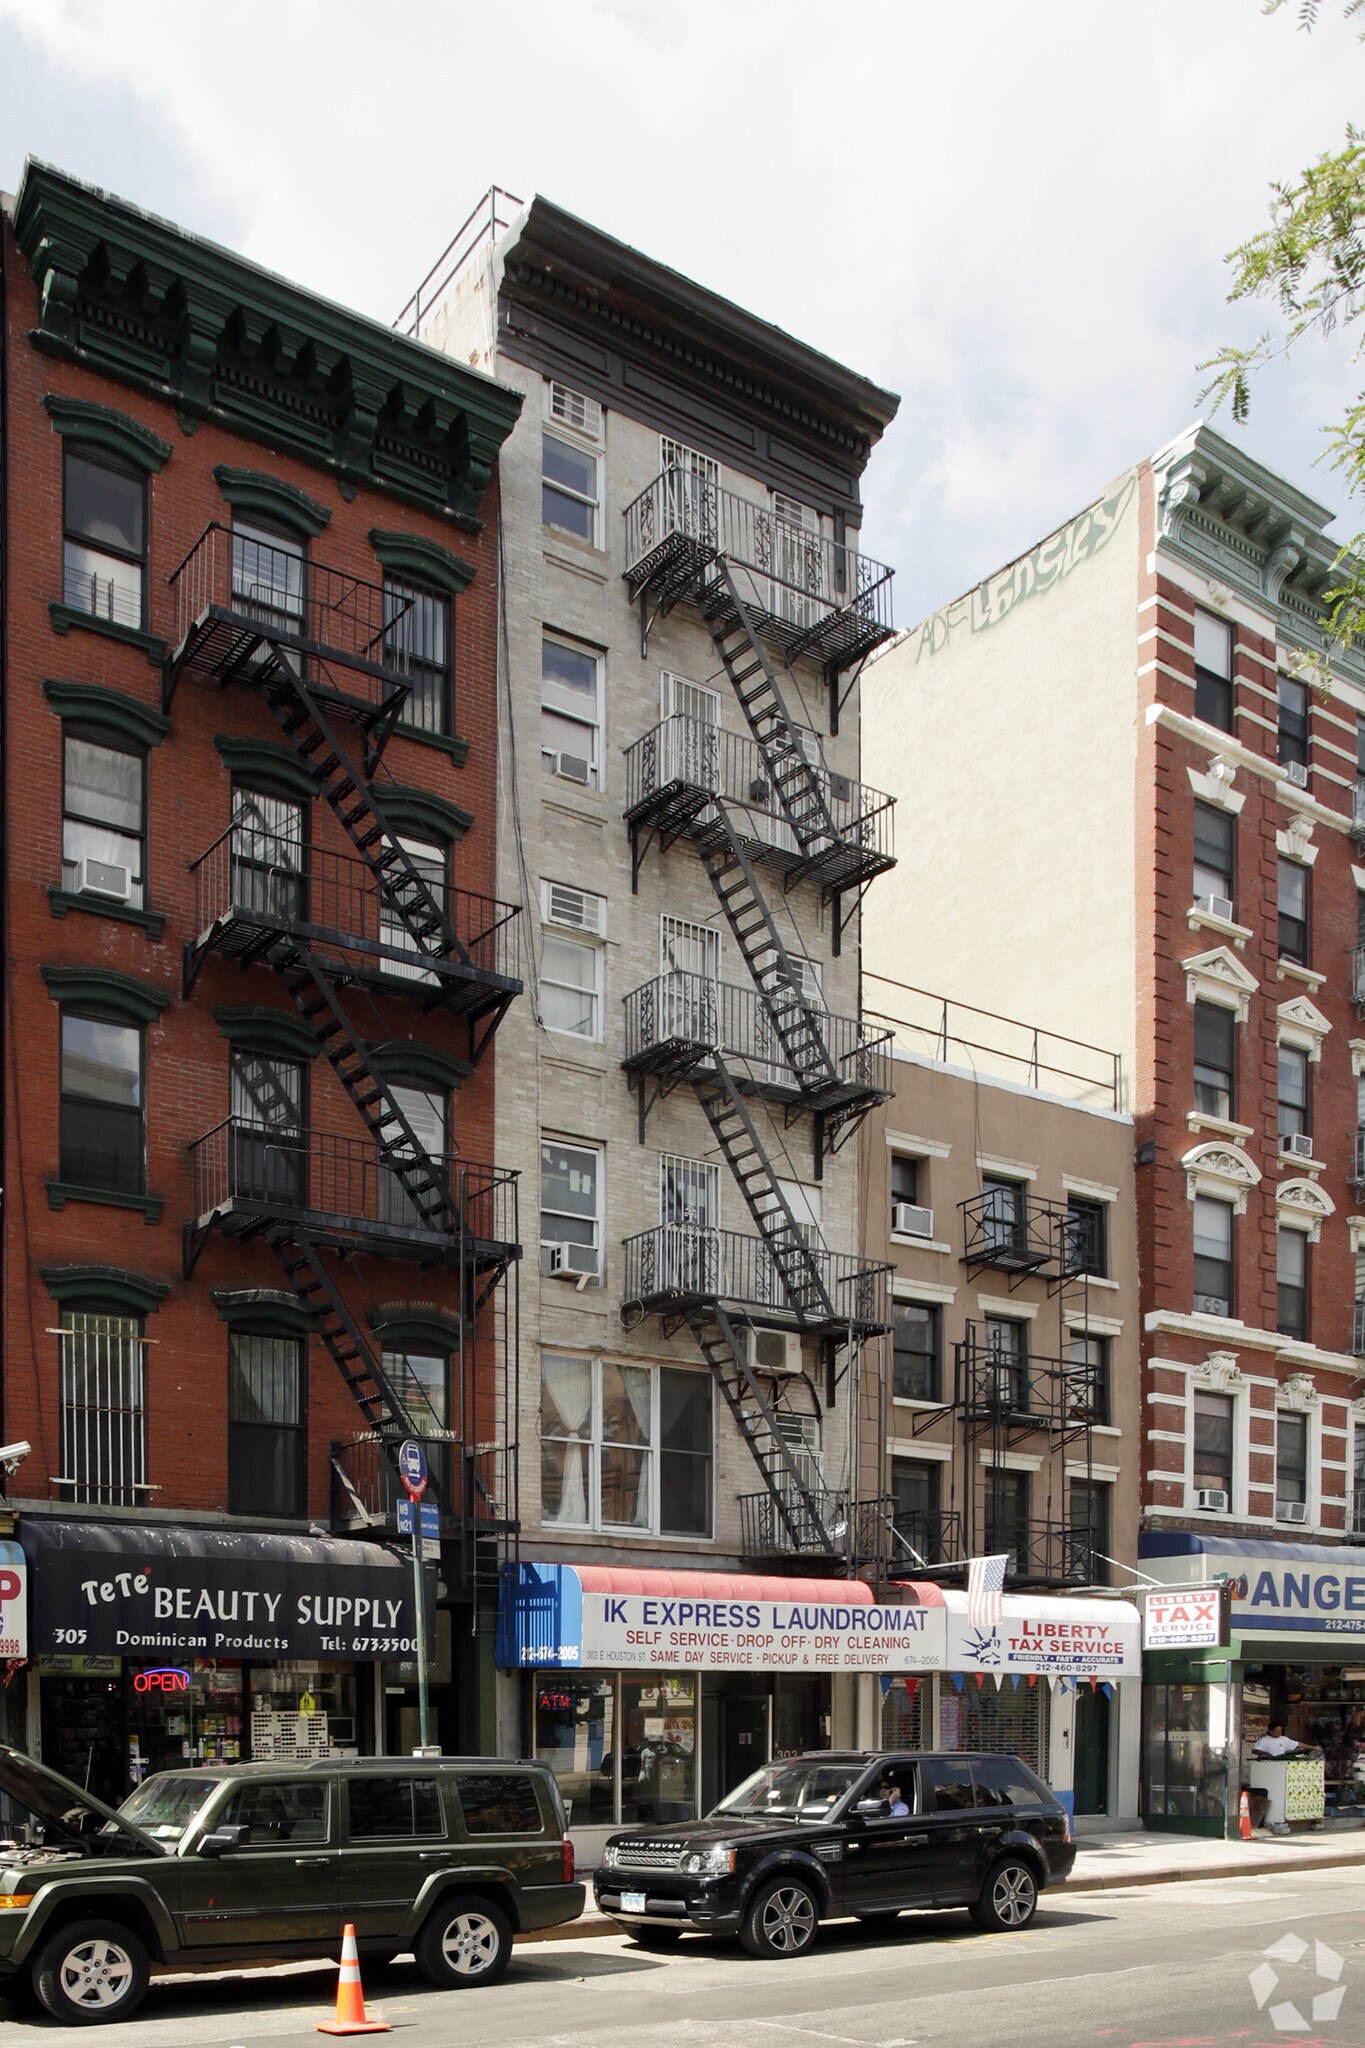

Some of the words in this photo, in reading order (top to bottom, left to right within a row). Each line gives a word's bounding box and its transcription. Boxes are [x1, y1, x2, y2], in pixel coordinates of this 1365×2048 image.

[154, 1587, 282, 1622] BEAUTY
[297, 1594, 403, 1629] SUPPLY
[1152, 1593, 1213, 1605] LIBERTY
[643, 1601, 761, 1628] EXPRESS
[773, 1607, 928, 1631] LAUNDROMAT
[1150, 1604, 1215, 1624] TAX
[1023, 1620, 1109, 1638] LIBERTY
[1152, 1623, 1213, 1633] SERVICE
[55, 1628, 87, 1644] 305
[116, 1630, 207, 1647] Dominican
[214, 1633, 289, 1650] Products
[320, 1636, 346, 1651] Tel:
[626, 1630, 662, 1645] SELF
[669, 1632, 729, 1647] SERVICE
[737, 1634, 774, 1648] DROP
[781, 1635, 806, 1649] OFF
[814, 1636, 840, 1649] DRY
[847, 1636, 911, 1649] CLEANING
[1008, 1638, 1044, 1651] TAX
[1049, 1640, 1124, 1654] SERVICE
[606, 1651, 637, 1662] HOUSTON
[650, 1650, 680, 1663] SAME
[685, 1651, 705, 1663] DAY
[710, 1651, 753, 1664] SERVICE
[762, 1653, 798, 1665] PICKUP
[802, 1654, 809, 1665] &
[815, 1654, 839, 1665] FREE
[844, 1654, 890, 1665] DELIVERY
[904, 1656, 940, 1665] 674-2005
[1013, 1654, 1049, 1662] FRIENDLY
[1081, 1656, 1119, 1664] ACCURATE
[134, 1673, 187, 1692] OPEN
[541, 1694, 570, 1707] ATM
